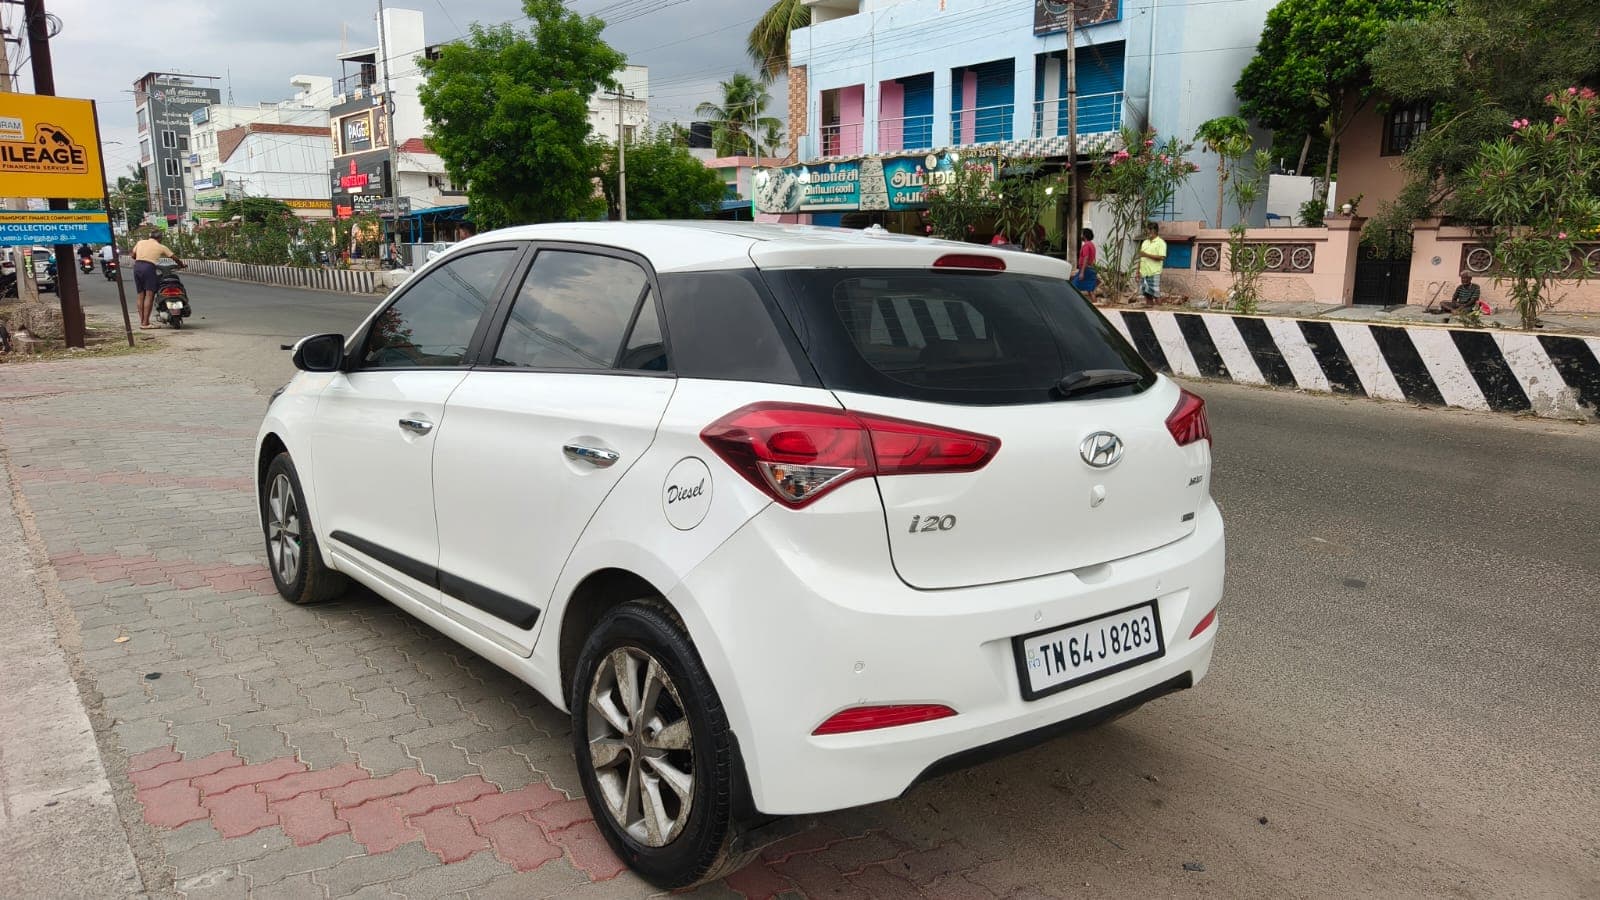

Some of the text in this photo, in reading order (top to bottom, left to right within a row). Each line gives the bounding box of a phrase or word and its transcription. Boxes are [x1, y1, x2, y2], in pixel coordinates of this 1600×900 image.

[1, 145, 84, 165] ILEAGE
[7, 223, 57, 232] COLLECTION
[59, 223, 88, 231] CENTRE
[667, 477, 705, 504] Diesel
[908, 514, 957, 534] i20
